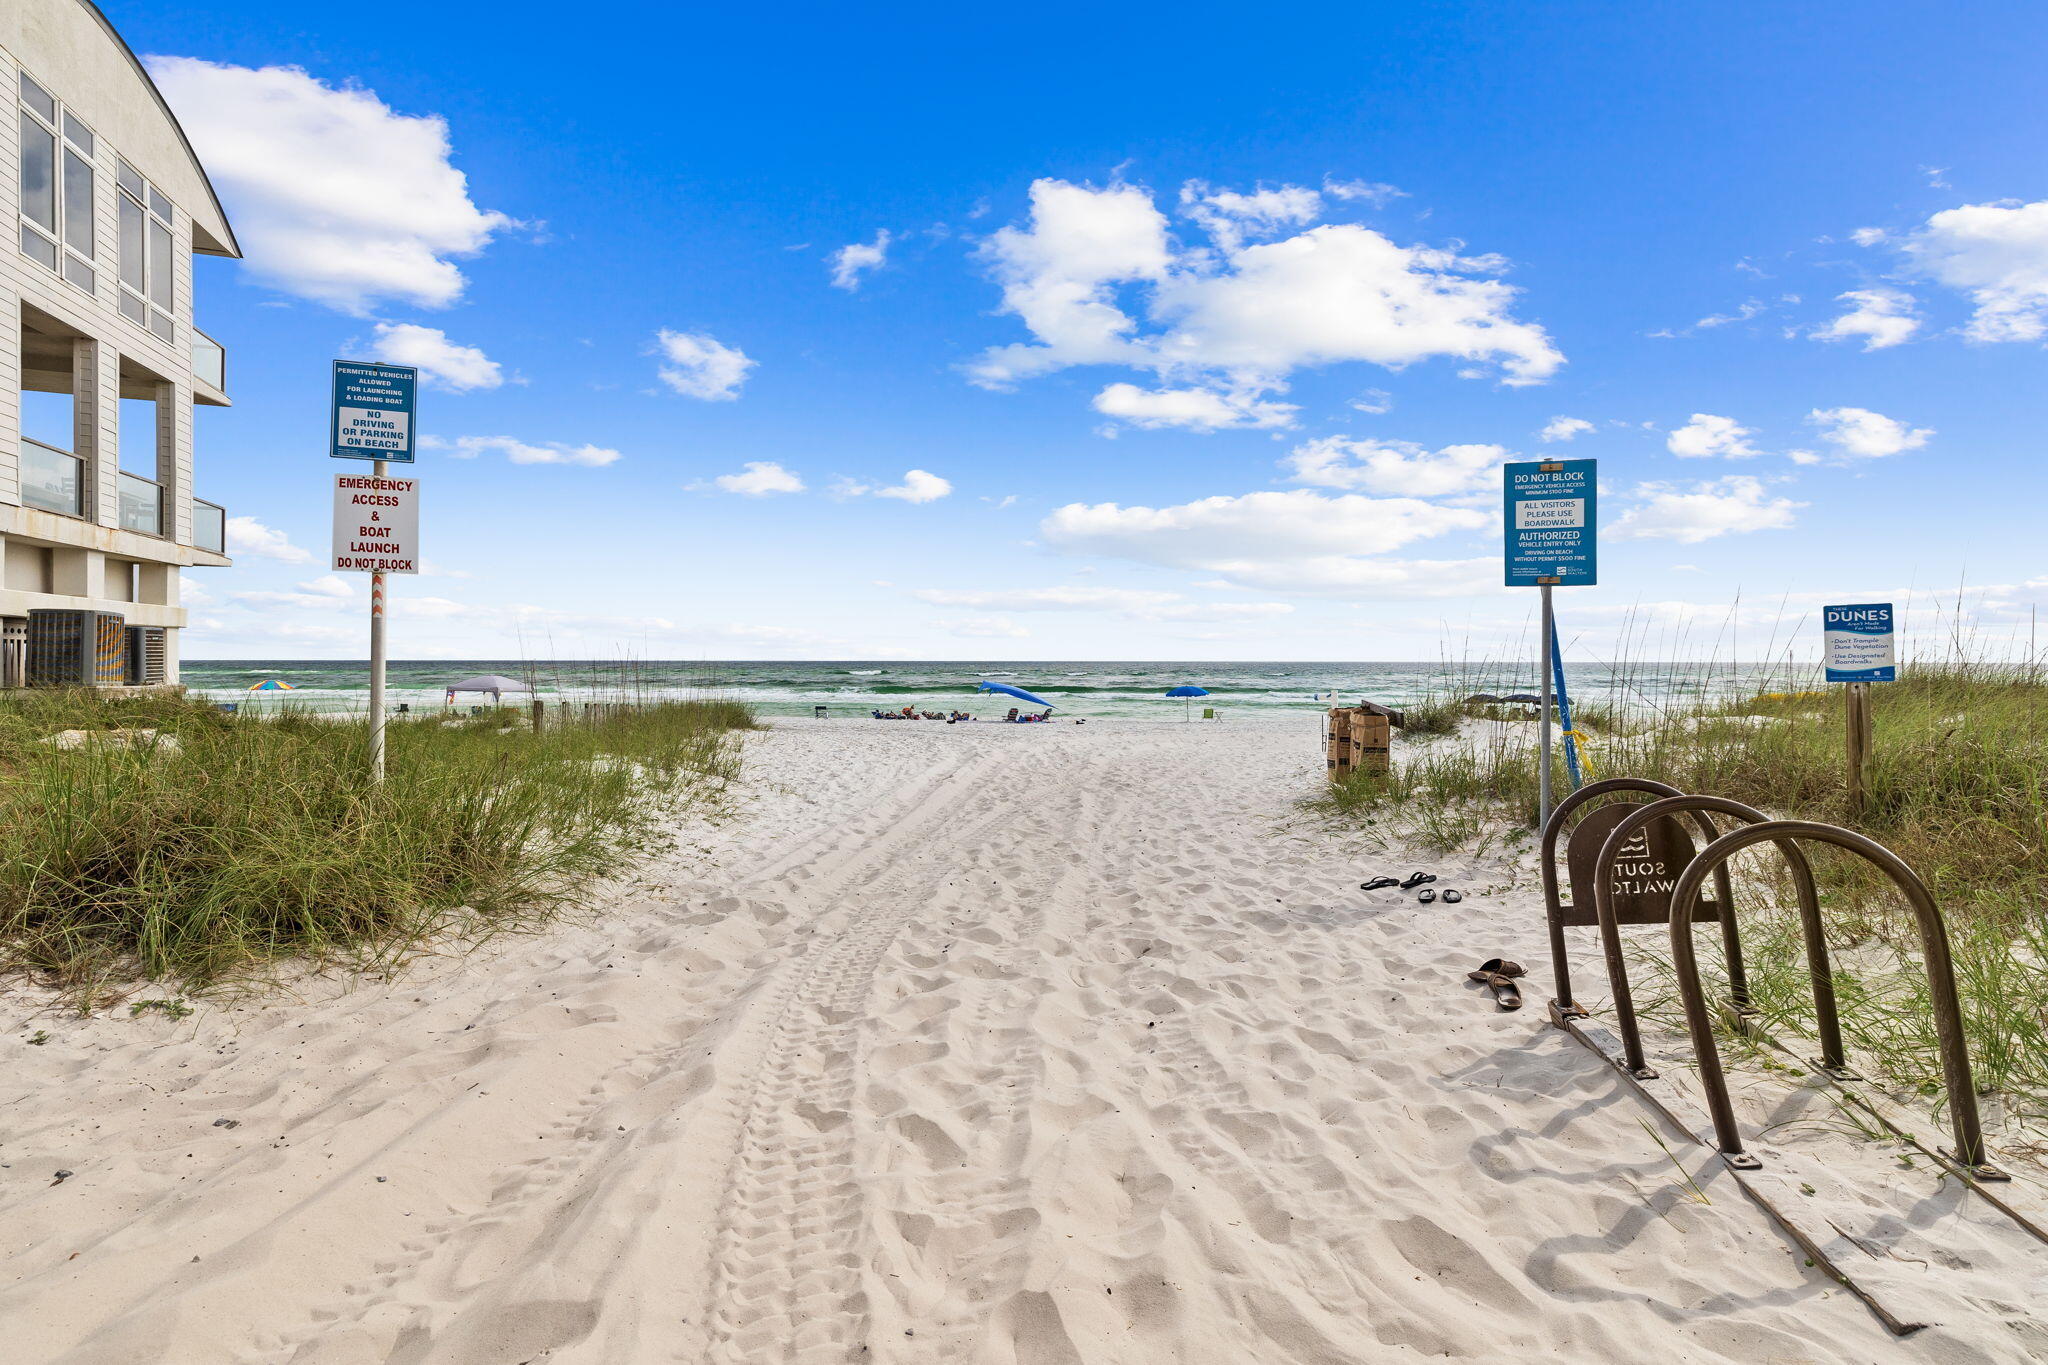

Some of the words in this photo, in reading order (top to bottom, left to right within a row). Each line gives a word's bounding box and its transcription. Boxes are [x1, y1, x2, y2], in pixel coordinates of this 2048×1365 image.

[338, 367, 378, 377] PERMITTED
[379, 371, 413, 380] VEHICLES
[359, 378, 391, 387] ALLOWED
[363, 387, 403, 396] LAUNCHING
[353, 395, 383, 403] LOADING
[367, 411, 381, 419] NO
[353, 418, 395, 429] DRIVING
[342, 427, 357, 436] OR
[360, 429, 404, 440] PARKING
[347, 437, 361, 446] ON
[364, 439, 399, 449] BEACH
[1515, 474, 1529, 483] DO
[1531, 473, 1550, 483] NOT
[1552, 472, 1584, 481] BLOCK
[339, 478, 412, 492] EMERGENCY
[352, 495, 399, 507] ACCESS
[1540, 501, 1576, 509] VISITORS
[371, 511, 380, 522] &
[1526, 510, 1556, 518] PLEASE
[1557, 509, 1573, 517] USE
[1524, 519, 1575, 527] BOARDWALK
[359, 526, 391, 538] BOAT
[1519, 531, 1580, 541] AUTHORIZED
[351, 542, 400, 554] LAUNCH
[338, 557, 352, 568] DO
[355, 558, 376, 569] NOT
[378, 559, 412, 570] BLOCK
[1828, 609, 1889, 622] DUNES
